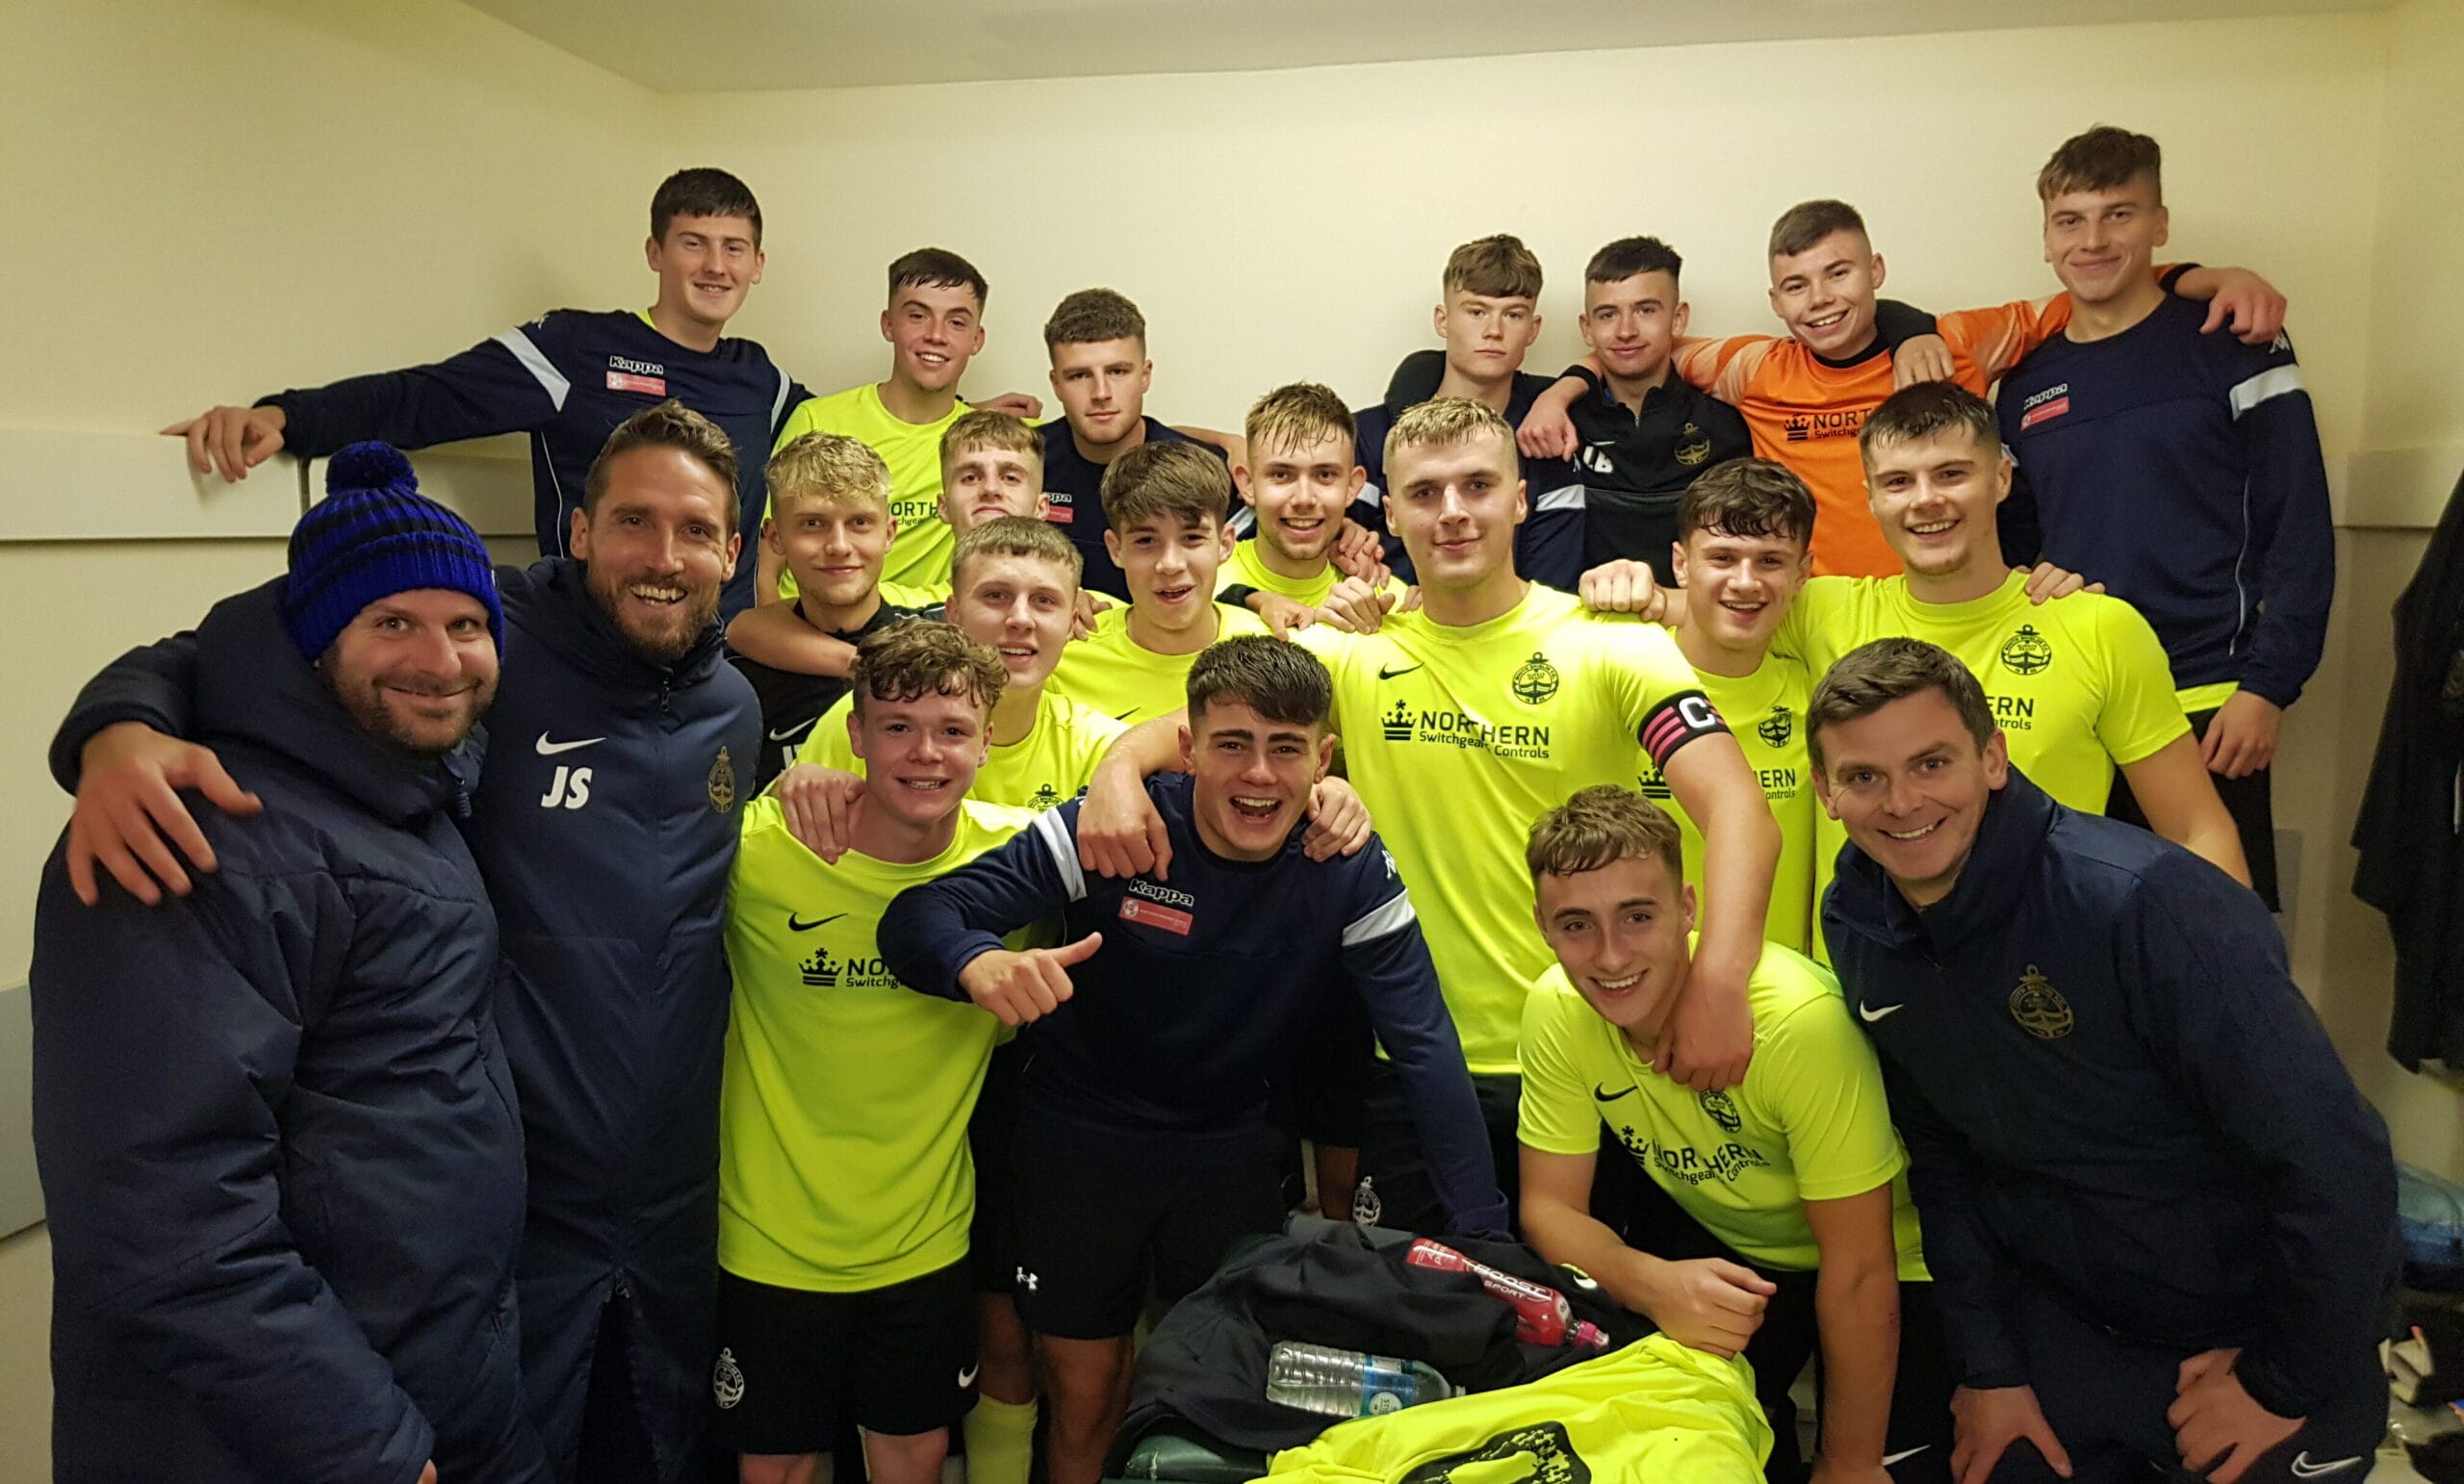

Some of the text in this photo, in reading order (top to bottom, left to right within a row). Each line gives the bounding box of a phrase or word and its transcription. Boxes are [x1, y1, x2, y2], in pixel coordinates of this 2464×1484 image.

[609, 355, 664, 375] Kappa
[1814, 426, 1860, 440] Switchg
[889, 501, 937, 517] ORTH
[1679, 697, 1716, 729] C
[1421, 710, 1550, 746] NORHERN
[1494, 745, 1550, 758] Controls
[541, 766, 593, 809] JS
[1129, 879, 1194, 907] Kappa
[1652, 1138, 1764, 1174] NORHERN
[1483, 1279, 1527, 1298] SPORT
